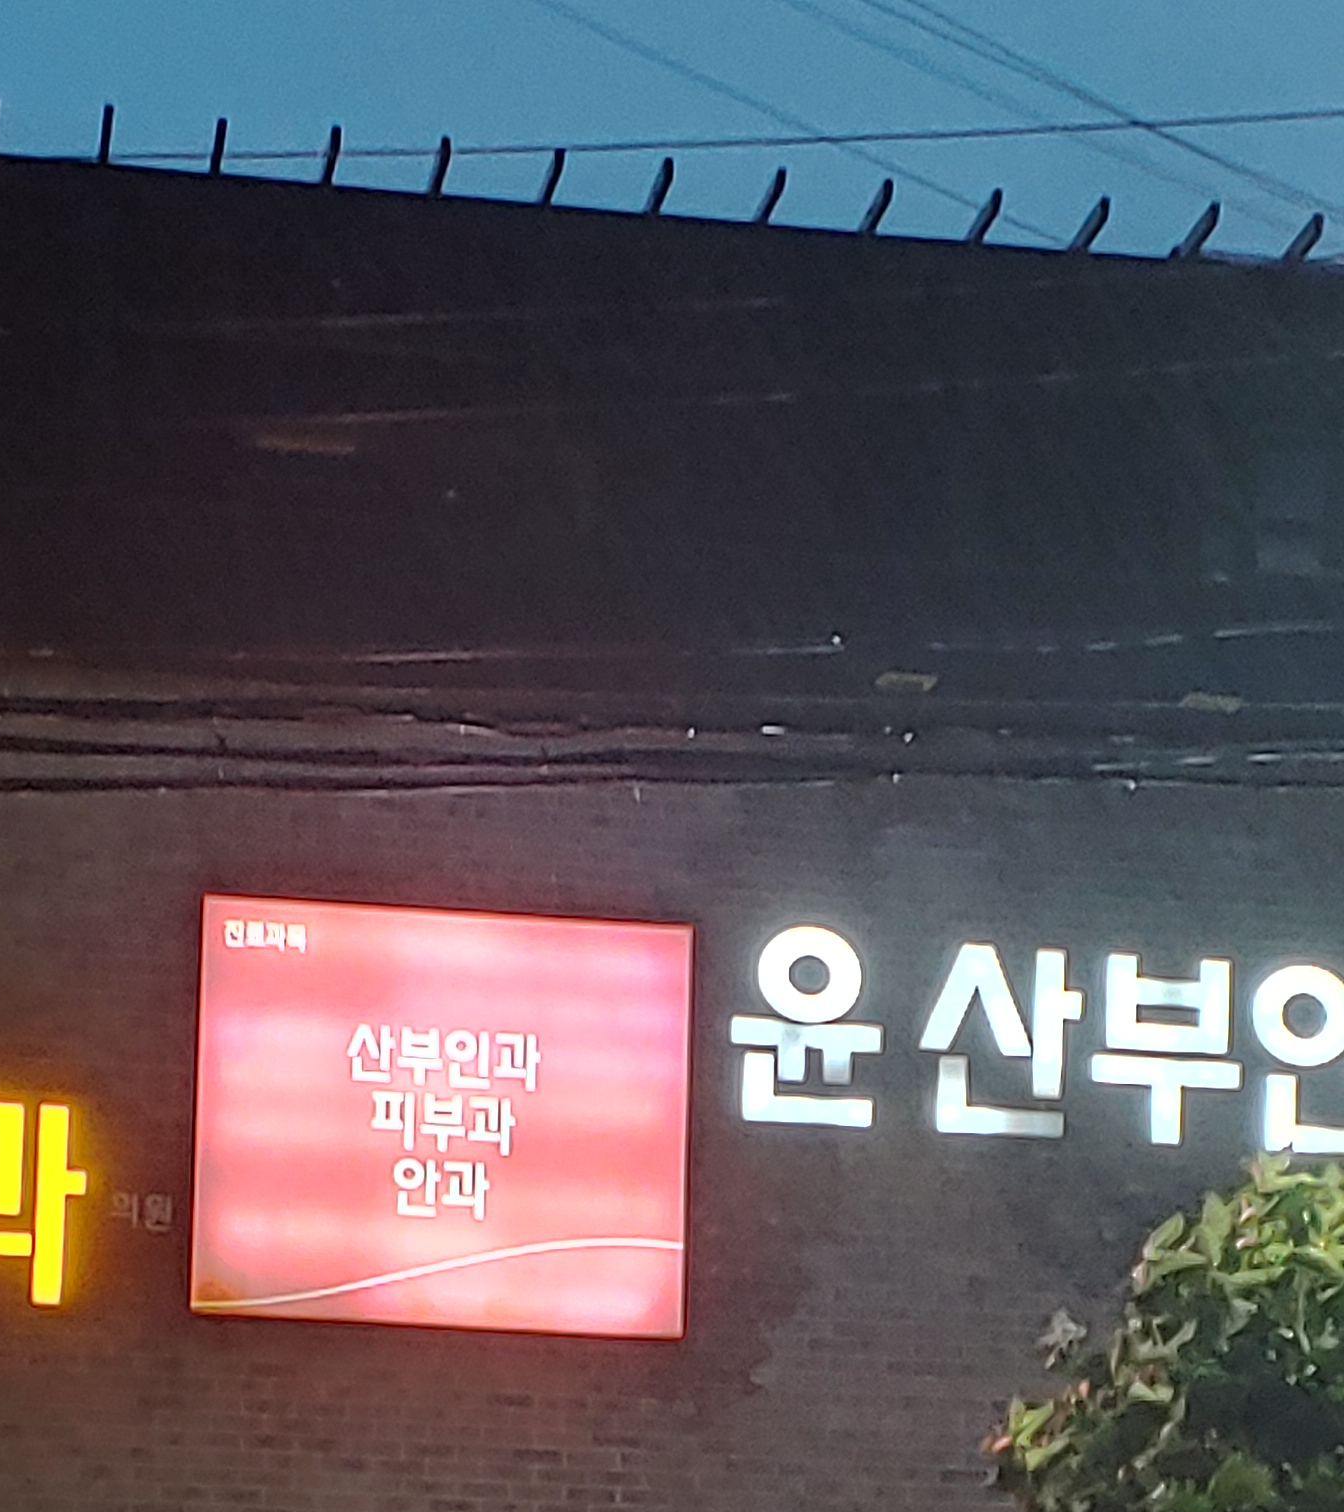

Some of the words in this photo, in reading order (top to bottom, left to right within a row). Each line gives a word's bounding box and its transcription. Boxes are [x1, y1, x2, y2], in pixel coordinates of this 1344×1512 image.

[346, 1022, 542, 1093] 산부인과
[729, 925, 883, 1129] 윤
[370, 1089, 517, 1157] 피부과
[110, 1190, 173, 1234] 의원
[392, 1156, 491, 1222] 안과
